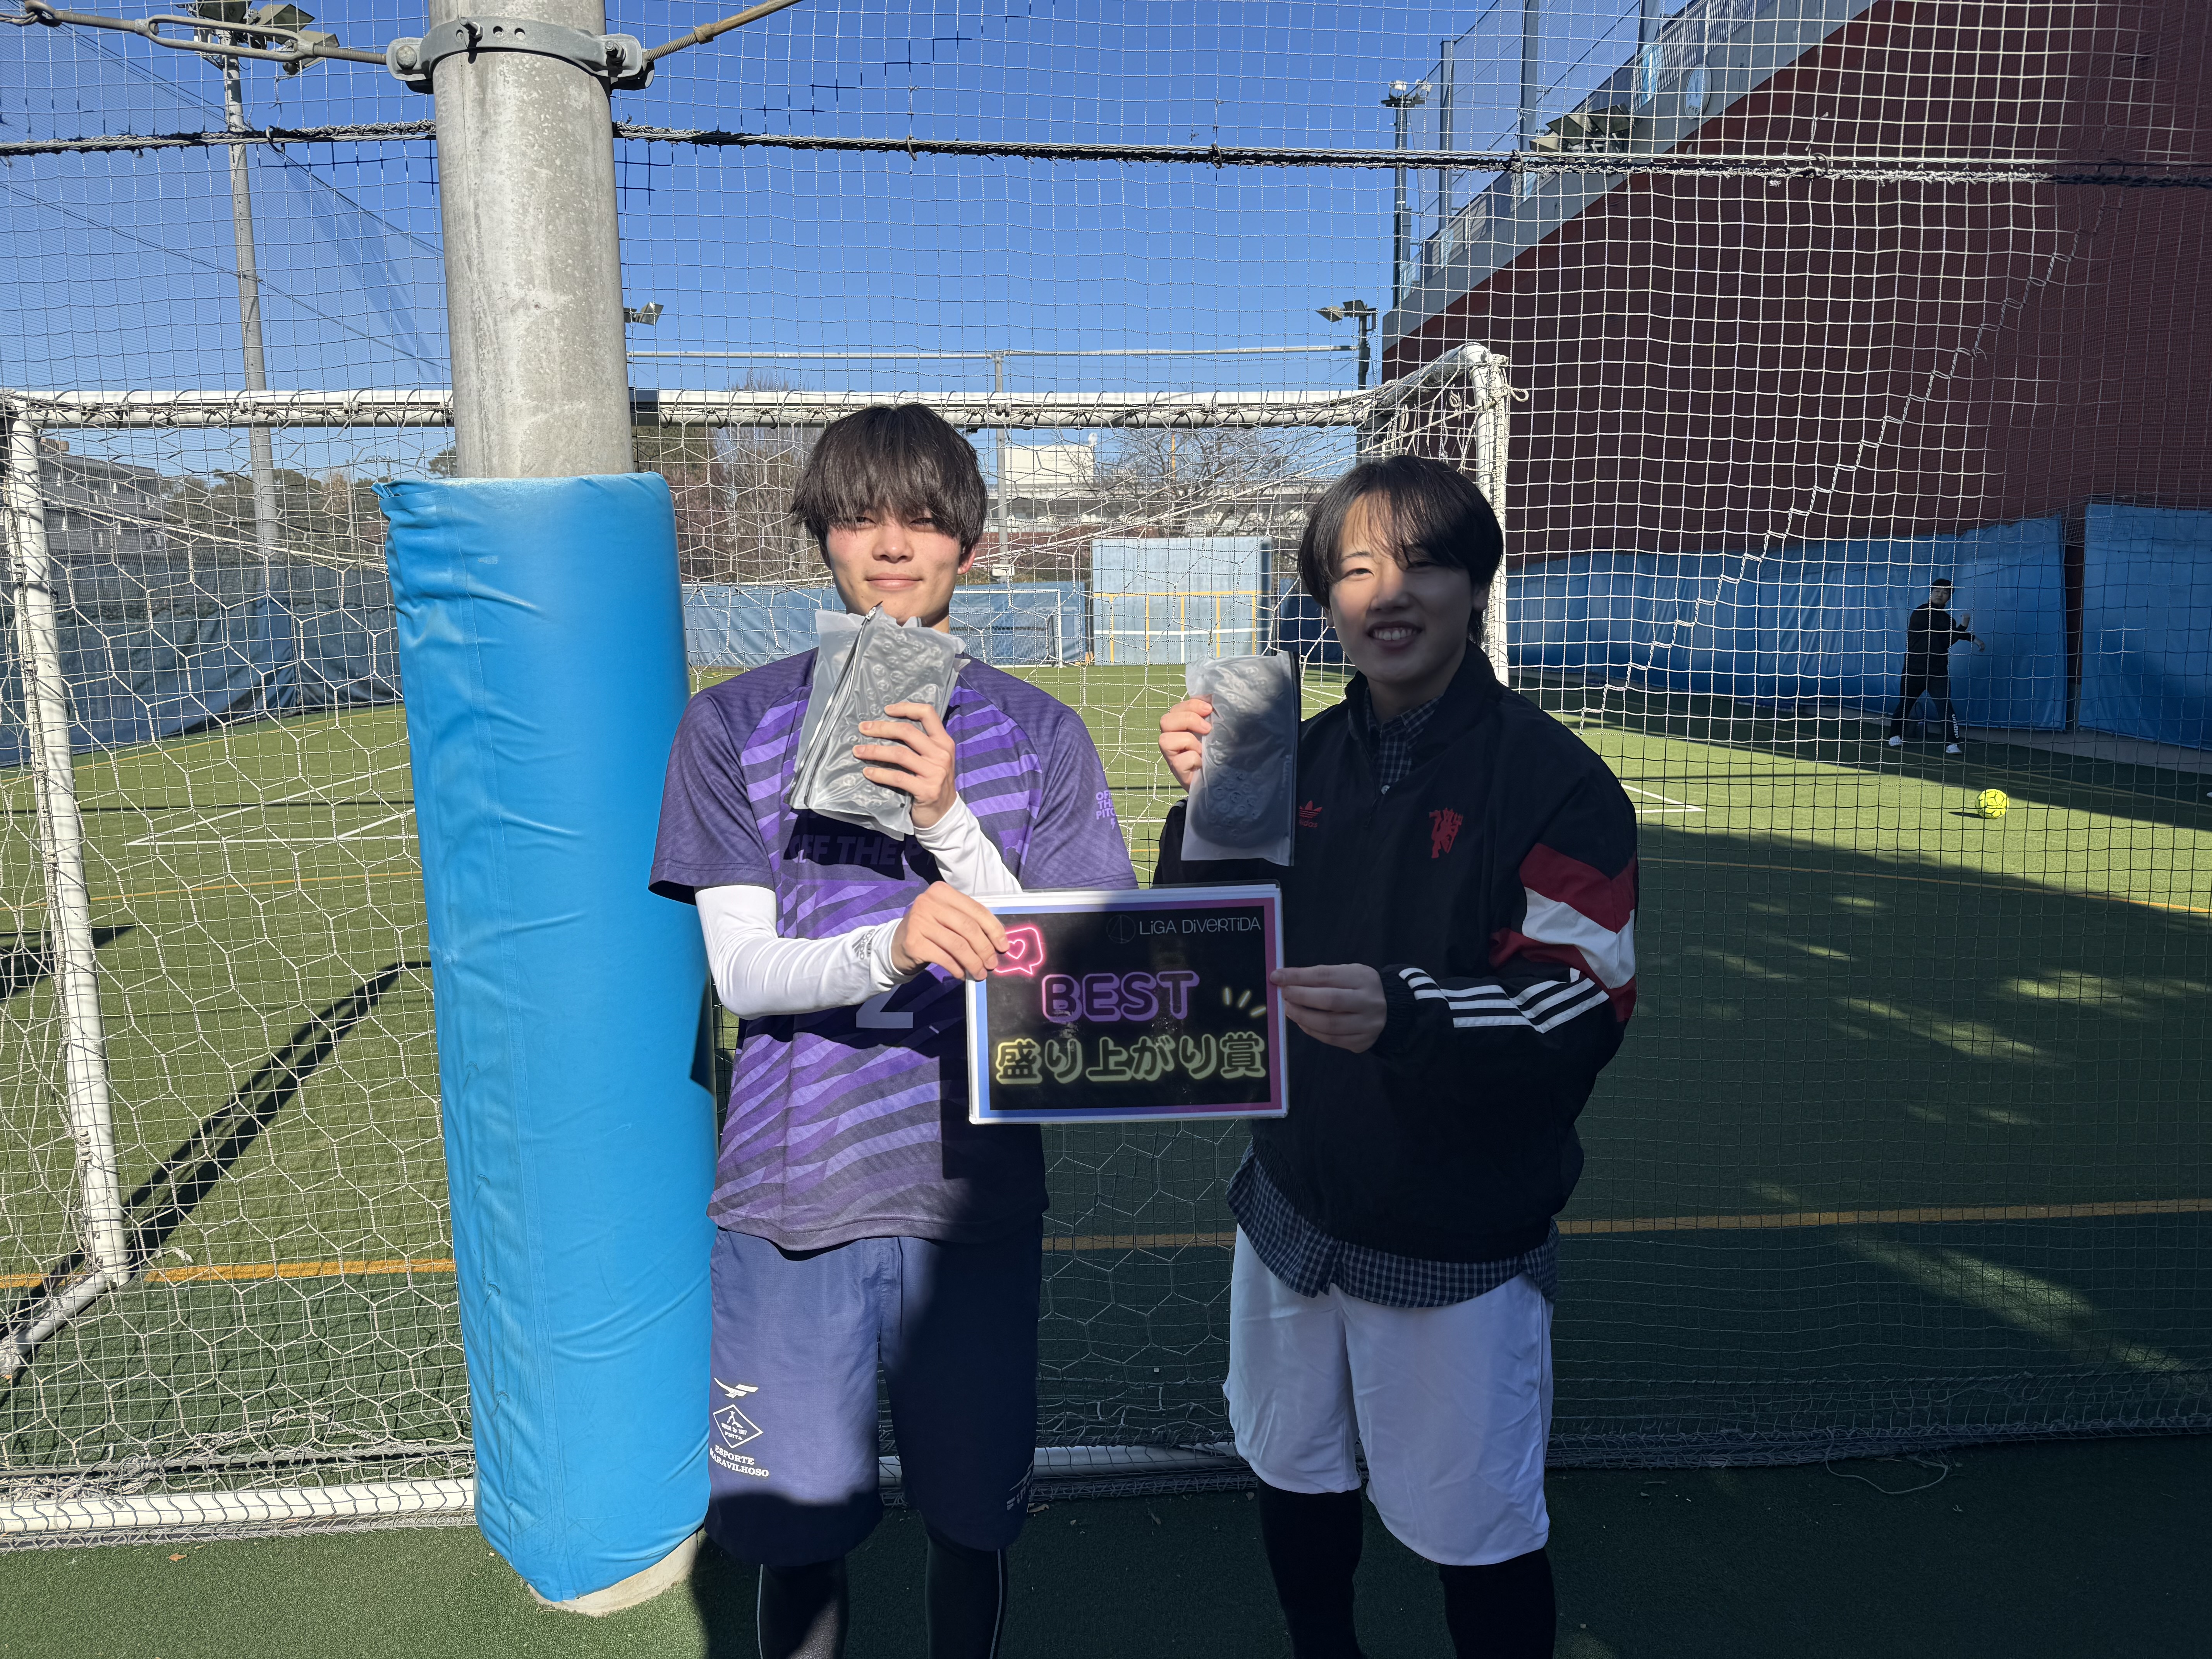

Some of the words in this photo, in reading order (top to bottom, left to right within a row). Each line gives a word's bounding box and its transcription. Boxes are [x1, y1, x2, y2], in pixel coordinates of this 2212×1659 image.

[1096, 790, 1111, 801] OF
[1096, 807, 1116, 820] PITC
[789, 834, 831, 864] OFF
[836, 836, 899, 865] THE
[860, 929, 875, 960] adidas
[1041, 970, 1200, 1023] BEST
[995, 1031, 1266, 1084] 盛り上がり賞
[715, 1444, 754, 1465] ESPORTE
